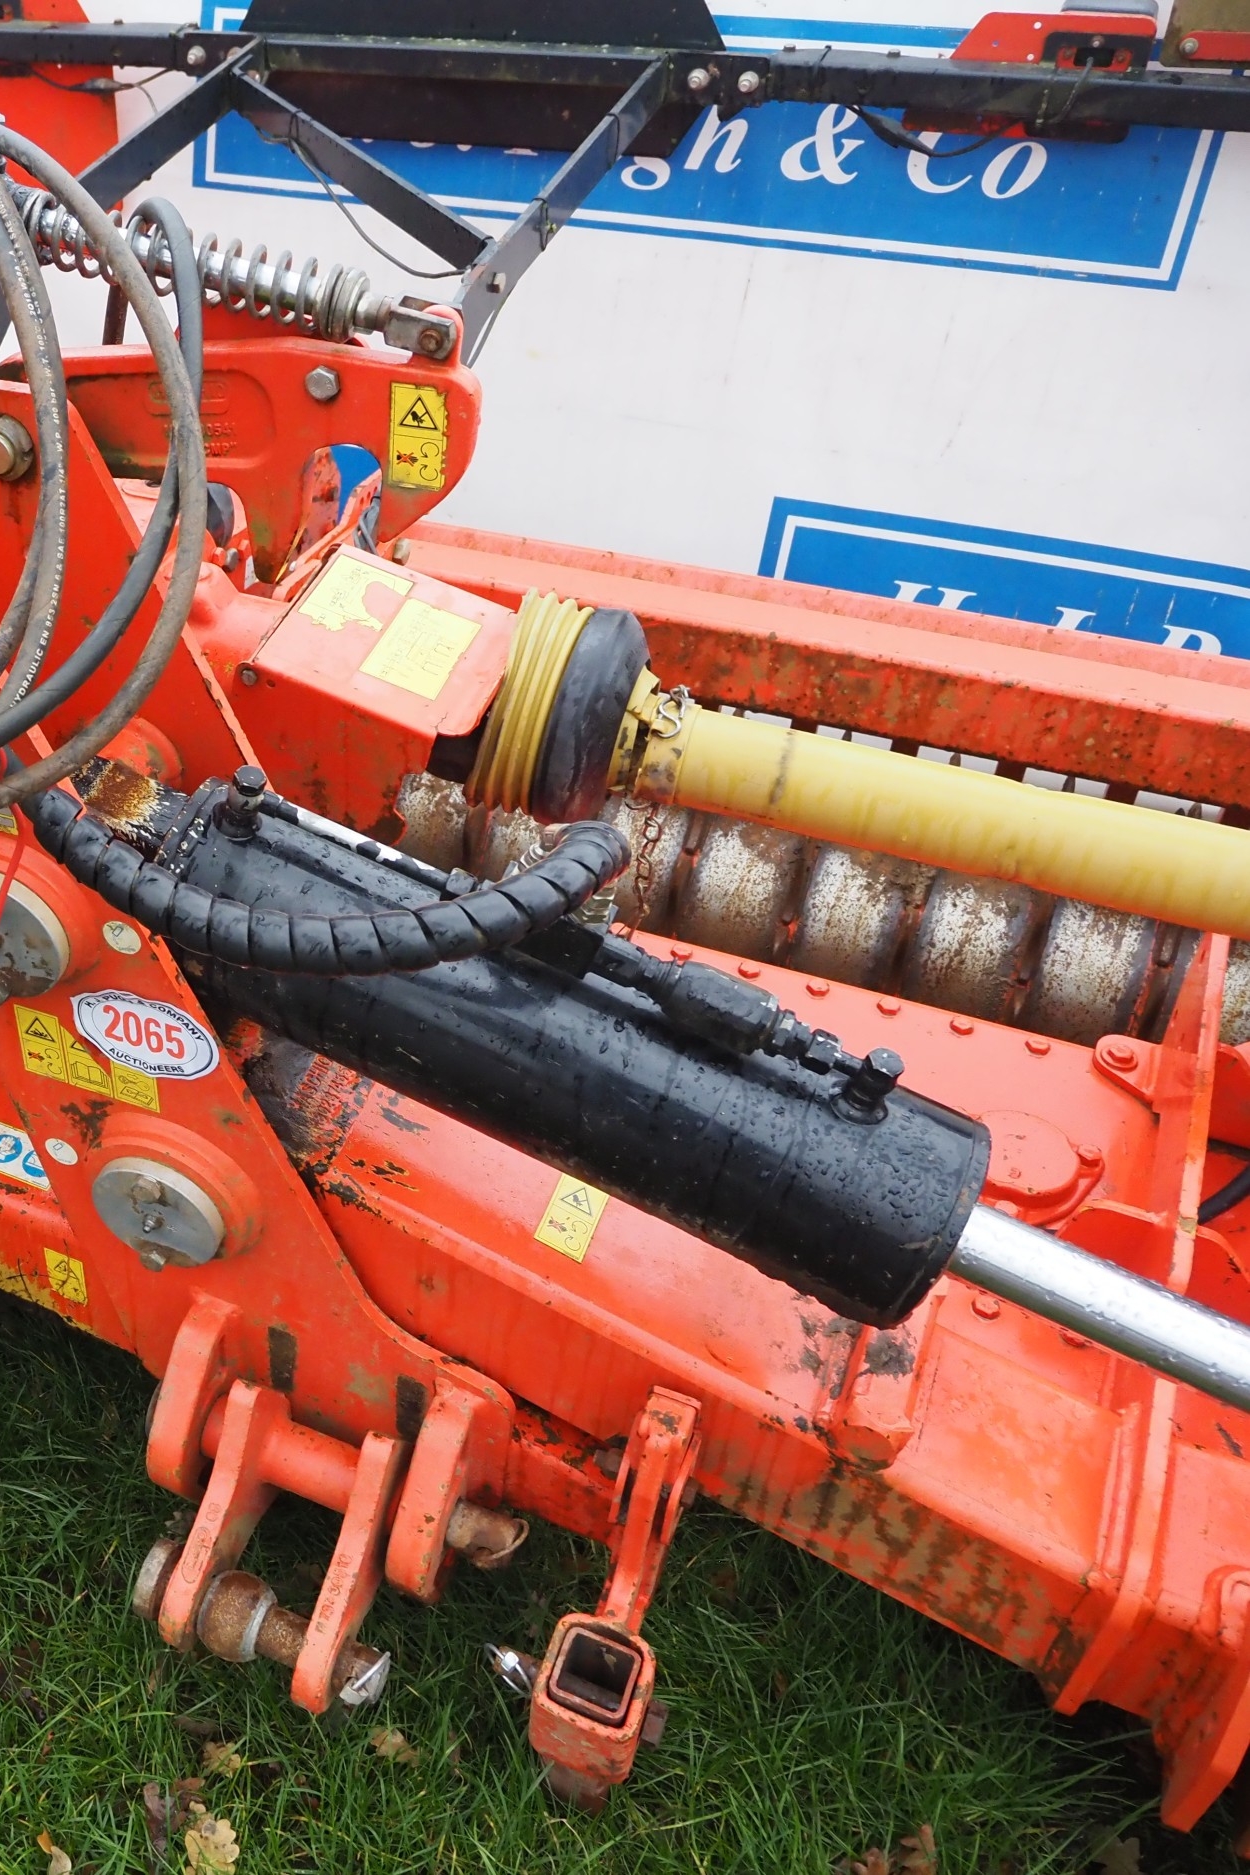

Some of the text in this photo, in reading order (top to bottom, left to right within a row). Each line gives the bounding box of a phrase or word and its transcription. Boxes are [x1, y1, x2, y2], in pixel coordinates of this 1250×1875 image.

[780, 103, 864, 185] &
[907, 131, 1047, 199] Co
[39, 629, 51, 647] EN
[103, 1004, 186, 1060] 2065
[149, 1003, 205, 1042] COMPANY
[108, 1047, 185, 1074] AUCTIONEERS
